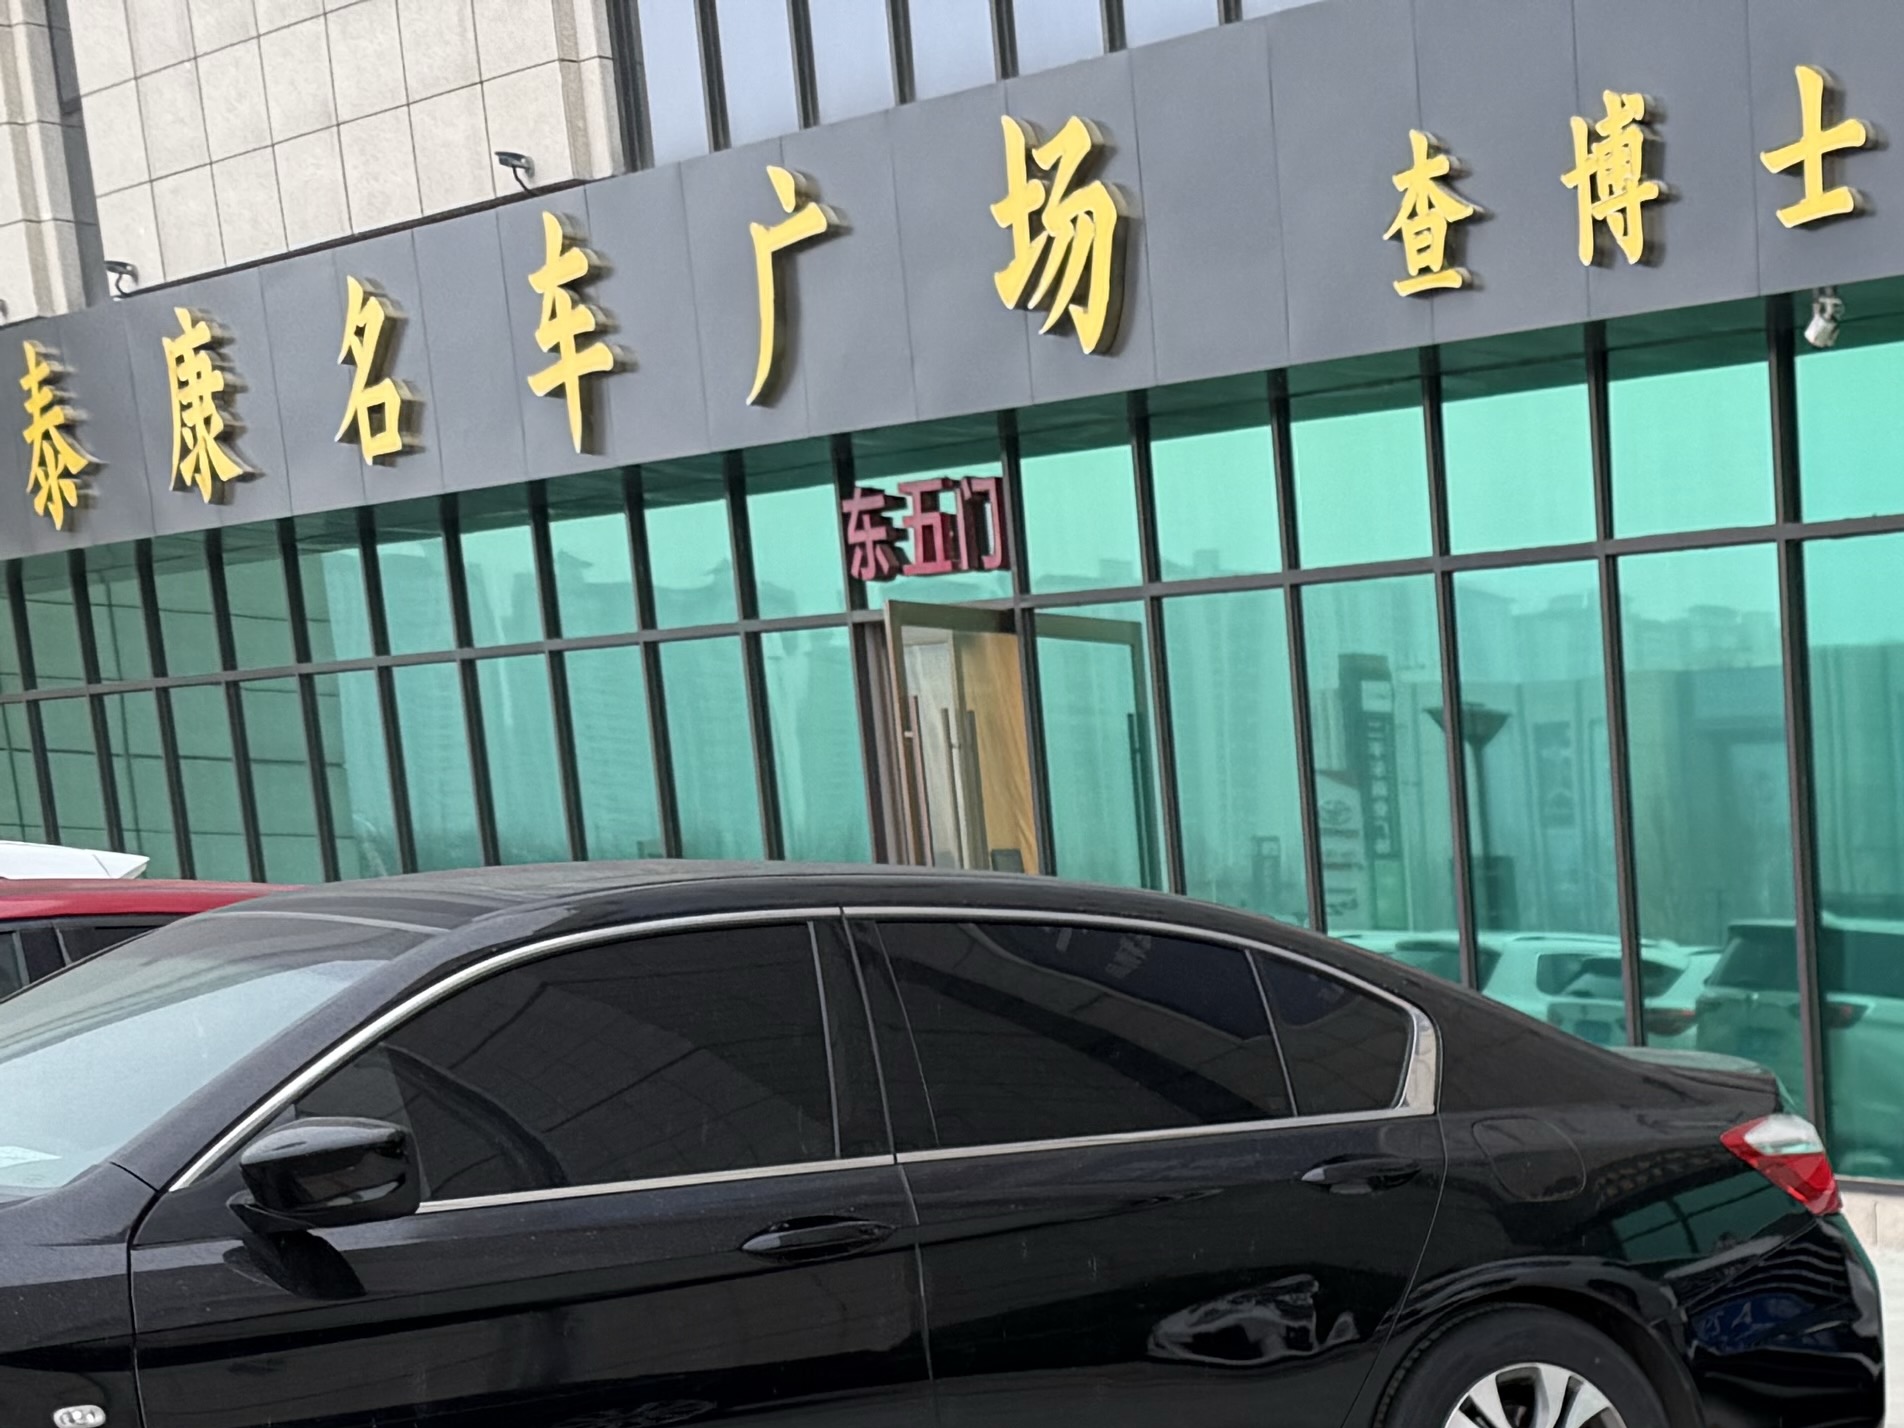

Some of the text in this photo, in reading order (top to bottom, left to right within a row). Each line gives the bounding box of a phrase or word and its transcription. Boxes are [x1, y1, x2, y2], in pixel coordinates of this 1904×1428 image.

[19, 113, 1130, 532] 泰康名车广场
[841, 475, 1003, 581] 东五门
